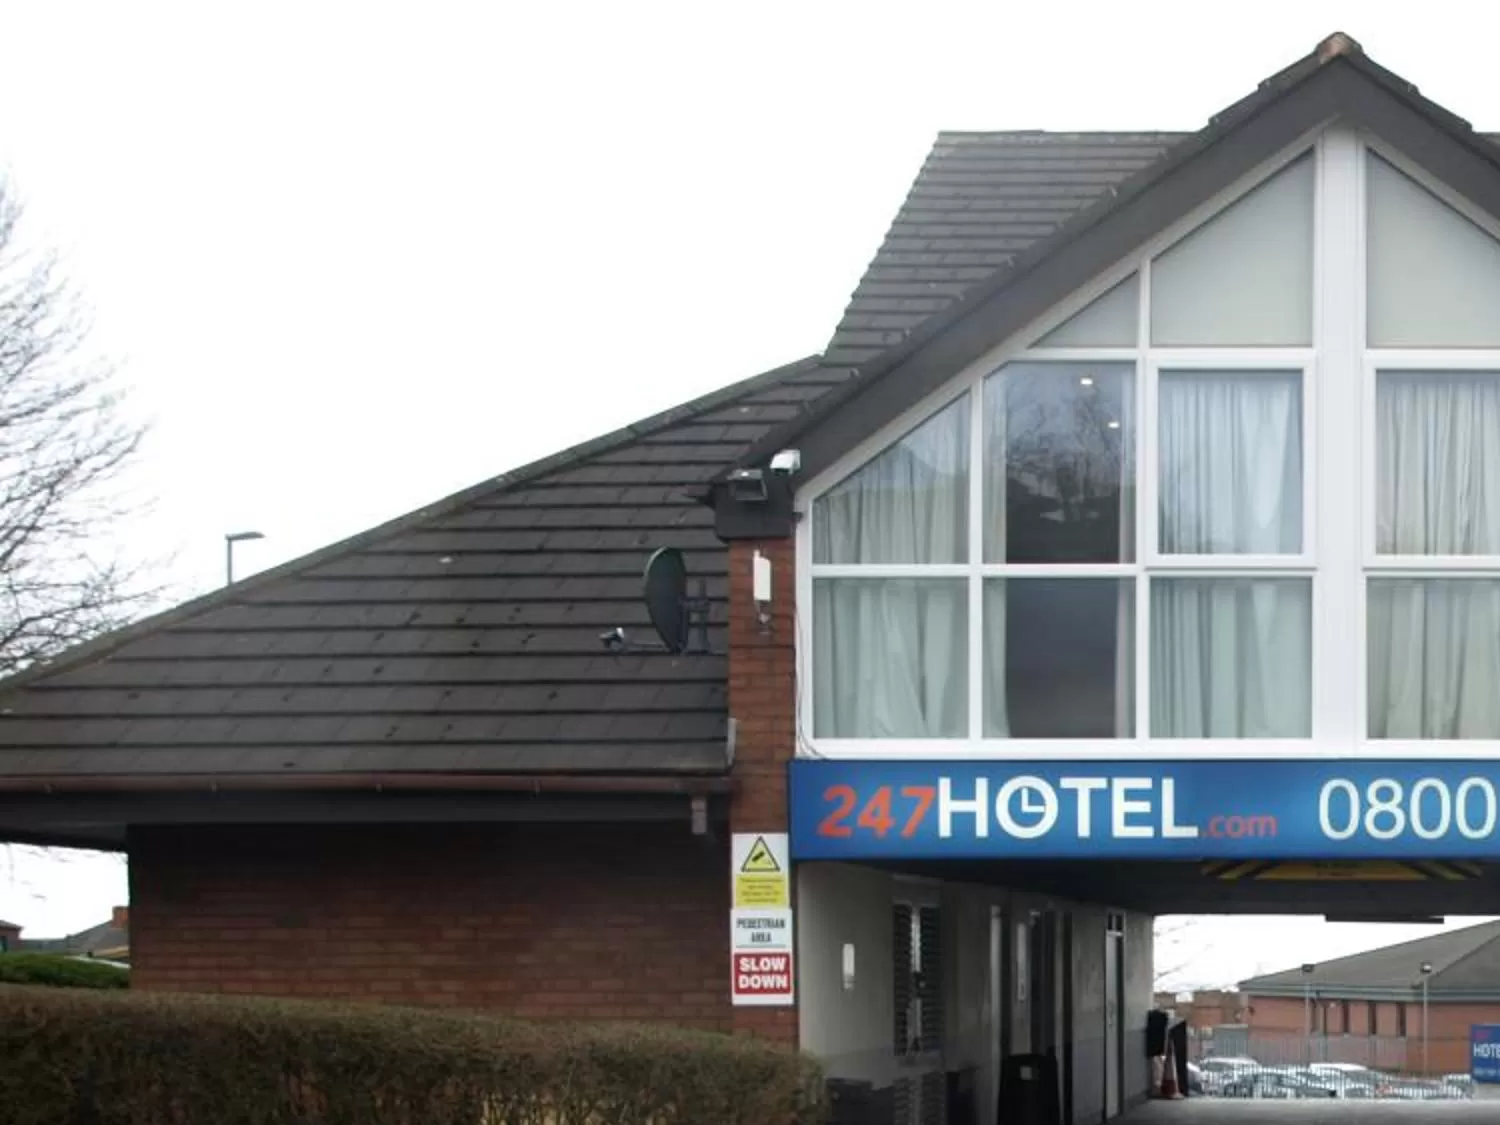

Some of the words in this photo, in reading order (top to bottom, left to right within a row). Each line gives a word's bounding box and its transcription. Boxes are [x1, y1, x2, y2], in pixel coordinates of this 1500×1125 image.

[1318, 777, 1498, 841] 0800
[751, 932, 772, 942] AREA
[739, 957, 786, 971] SLOW
[738, 974, 788, 989] DOWN
